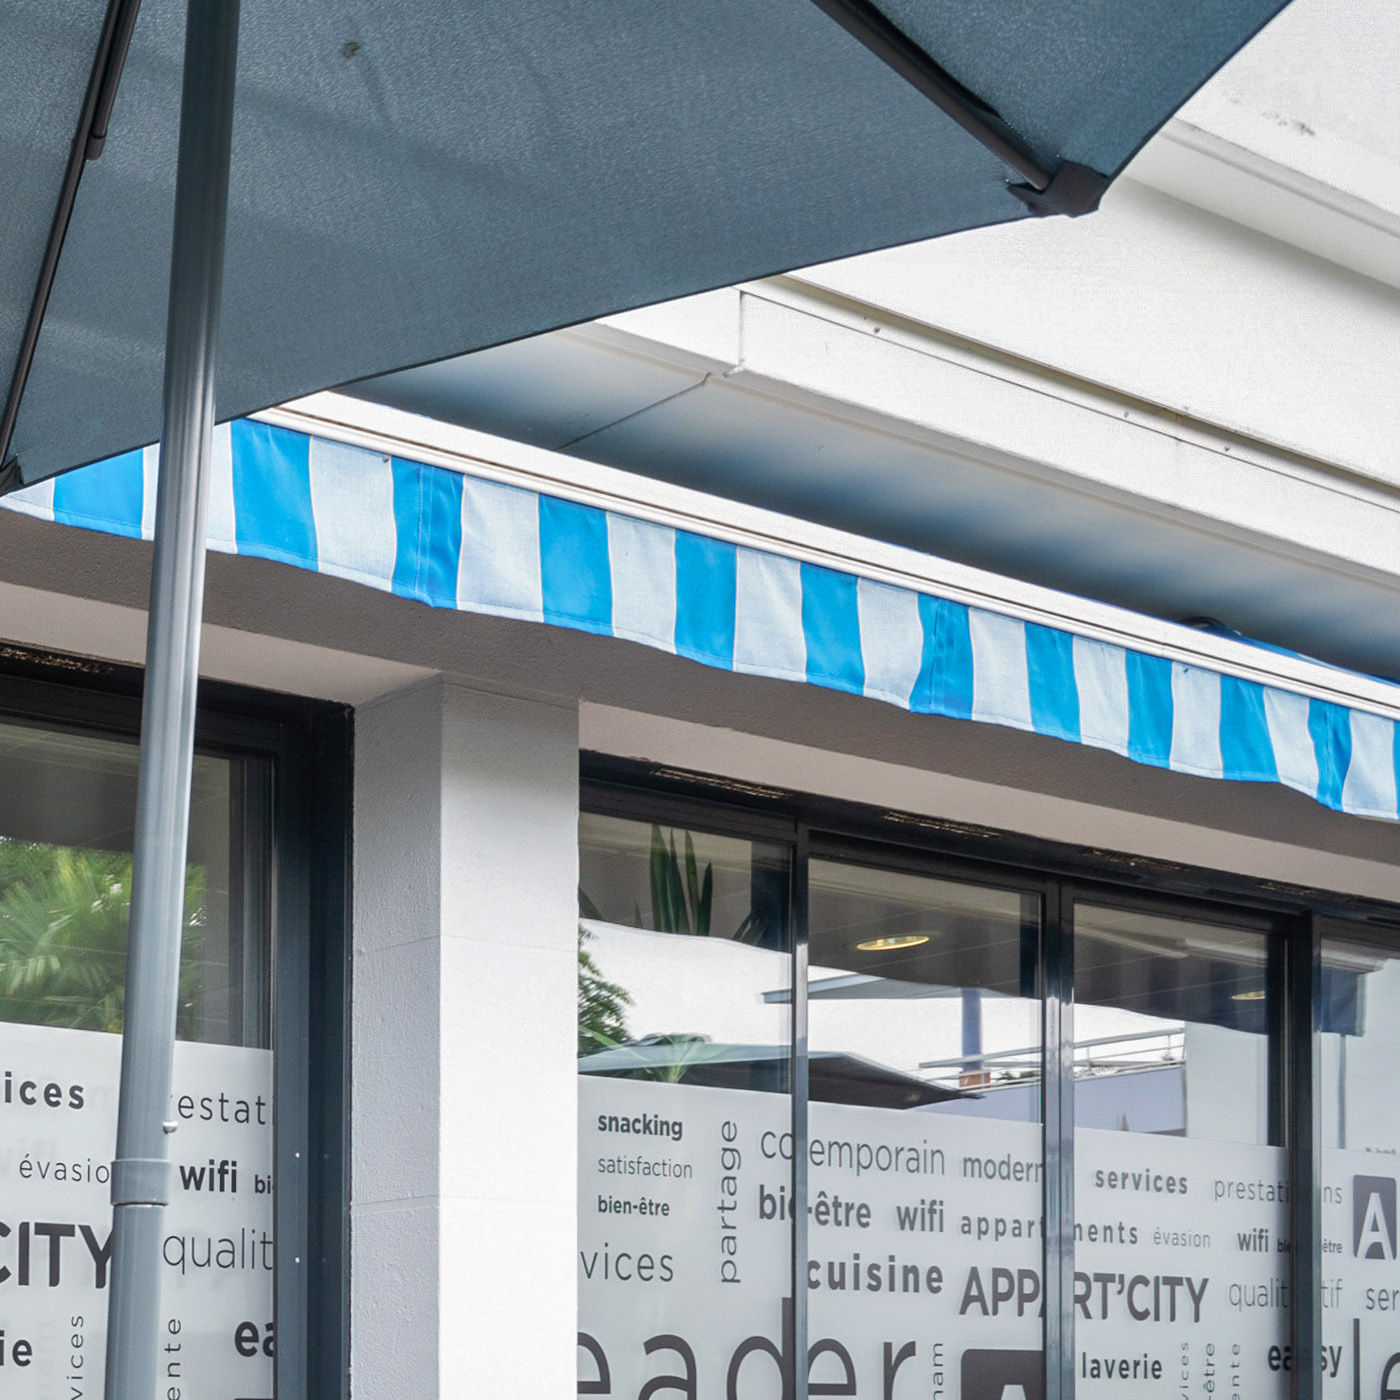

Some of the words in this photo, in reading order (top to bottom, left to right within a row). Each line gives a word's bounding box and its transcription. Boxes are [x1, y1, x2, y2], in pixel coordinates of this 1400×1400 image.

[172, 1093, 268, 1125] estat
[19, 1153, 112, 1184] évasio
[179, 1159, 238, 1193] wifi
[597, 1113, 683, 1141] snacking
[760, 1130, 945, 1177] coemporain
[1095, 1168, 1188, 1195] services
[1214, 1178, 1343, 1205] prestatins
[597, 1155, 693, 1179] satisfaction
[597, 1195, 670, 1217] bien-être
[759, 1184, 871, 1229] bi-être
[895, 1198, 944, 1233] wifi
[1153, 1227, 1211, 1248] évasion
[1238, 1228, 1268, 1252] wifi
[717, 1121, 741, 1283] partage
[162, 1227, 273, 1275] qualit
[578, 1242, 674, 1282] vices
[807, 1253, 944, 1294] cuisine
[959, 1266, 1209, 1323] APPRT'CITY
[1228, 1277, 1343, 1312] qualittif
[1082, 1351, 1163, 1379] laverie
